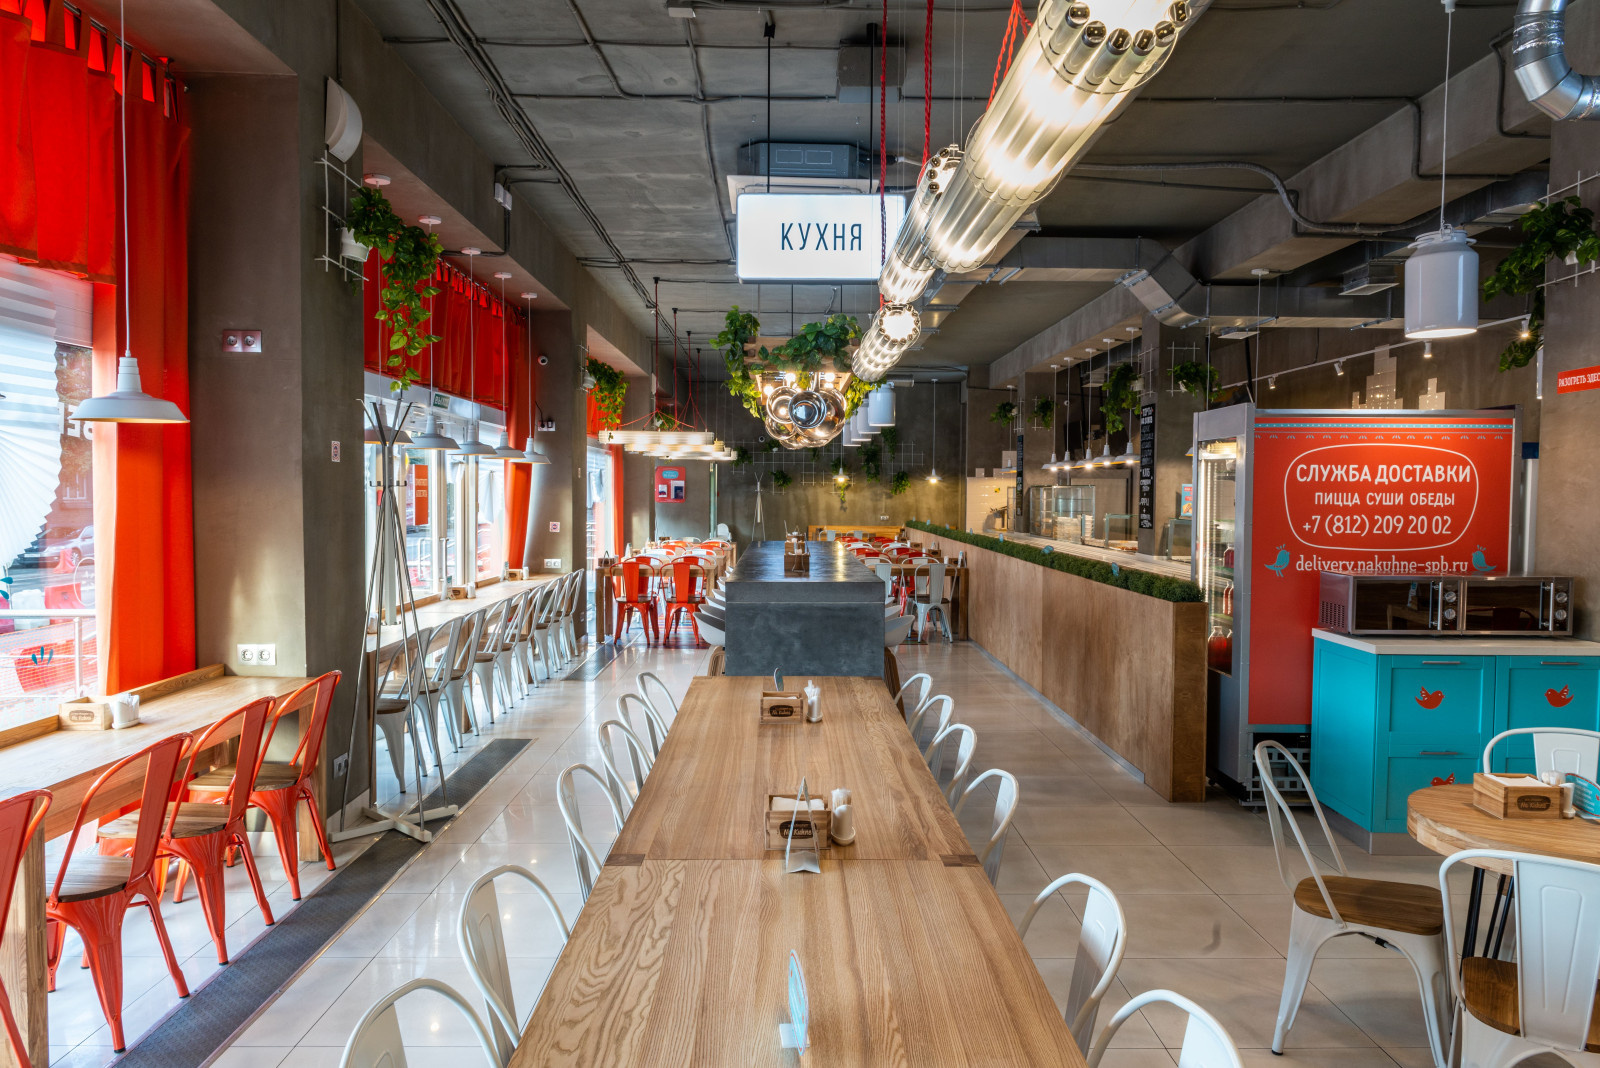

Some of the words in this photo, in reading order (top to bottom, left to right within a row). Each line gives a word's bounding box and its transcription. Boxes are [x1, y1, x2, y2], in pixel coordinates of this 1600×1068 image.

[781, 222, 862, 251] КУХНЯ
[1558, 375, 1586, 388] РАЗОГРЕТЬ
[1296, 464, 1371, 482] СЛУЖБА
[1374, 464, 1471, 485] ДОСТАВКИ
[1314, 492, 1361, 507] ПИЦЦА
[1366, 492, 1404, 506] СУШИ
[1409, 492, 1455, 508] ОБЕДЫ
[1302, 515, 1321, 534] +7
[1325, 514, 1370, 537] (812)
[1373, 515, 1404, 535] 209
[1407, 515, 1428, 535] 20
[1432, 515, 1452, 535] 02
[1295, 554, 1469, 573] delivery.nakuhne-spb.ru
